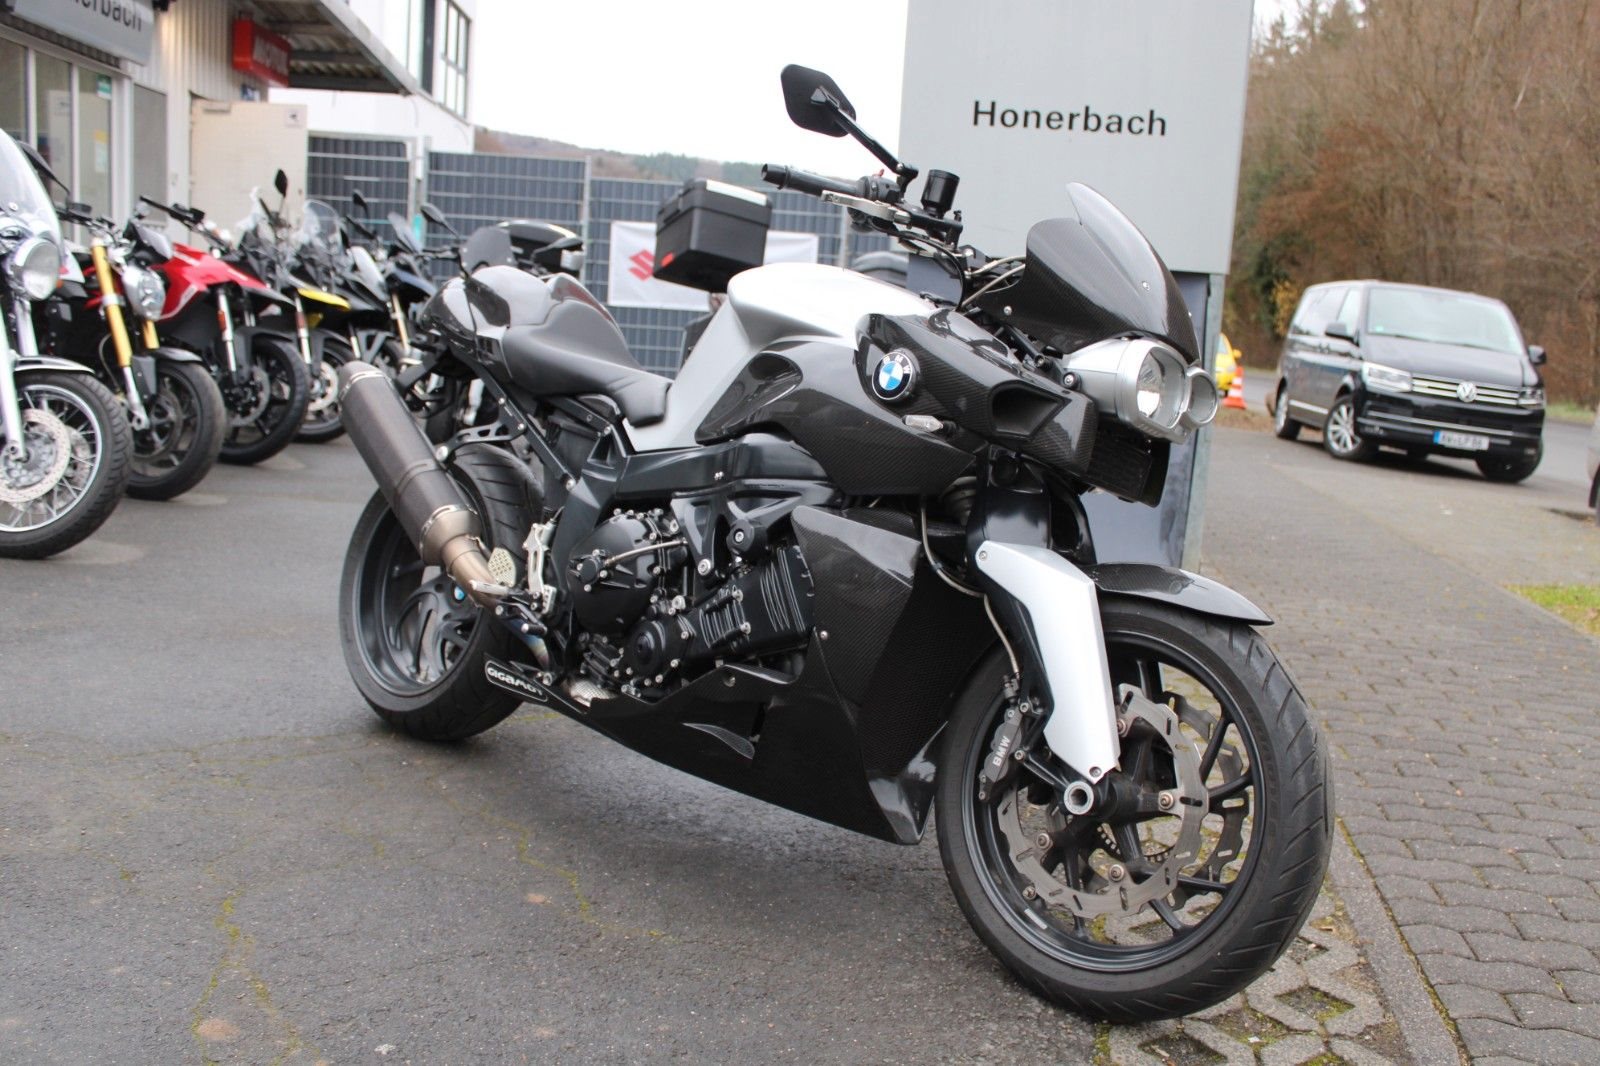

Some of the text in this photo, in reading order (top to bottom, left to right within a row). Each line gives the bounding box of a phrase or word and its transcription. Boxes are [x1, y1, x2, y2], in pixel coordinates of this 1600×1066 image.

[972, 99, 1167, 136] Honerbach
[882, 354, 911, 375] BMW
[992, 735, 1011, 767] BMW
